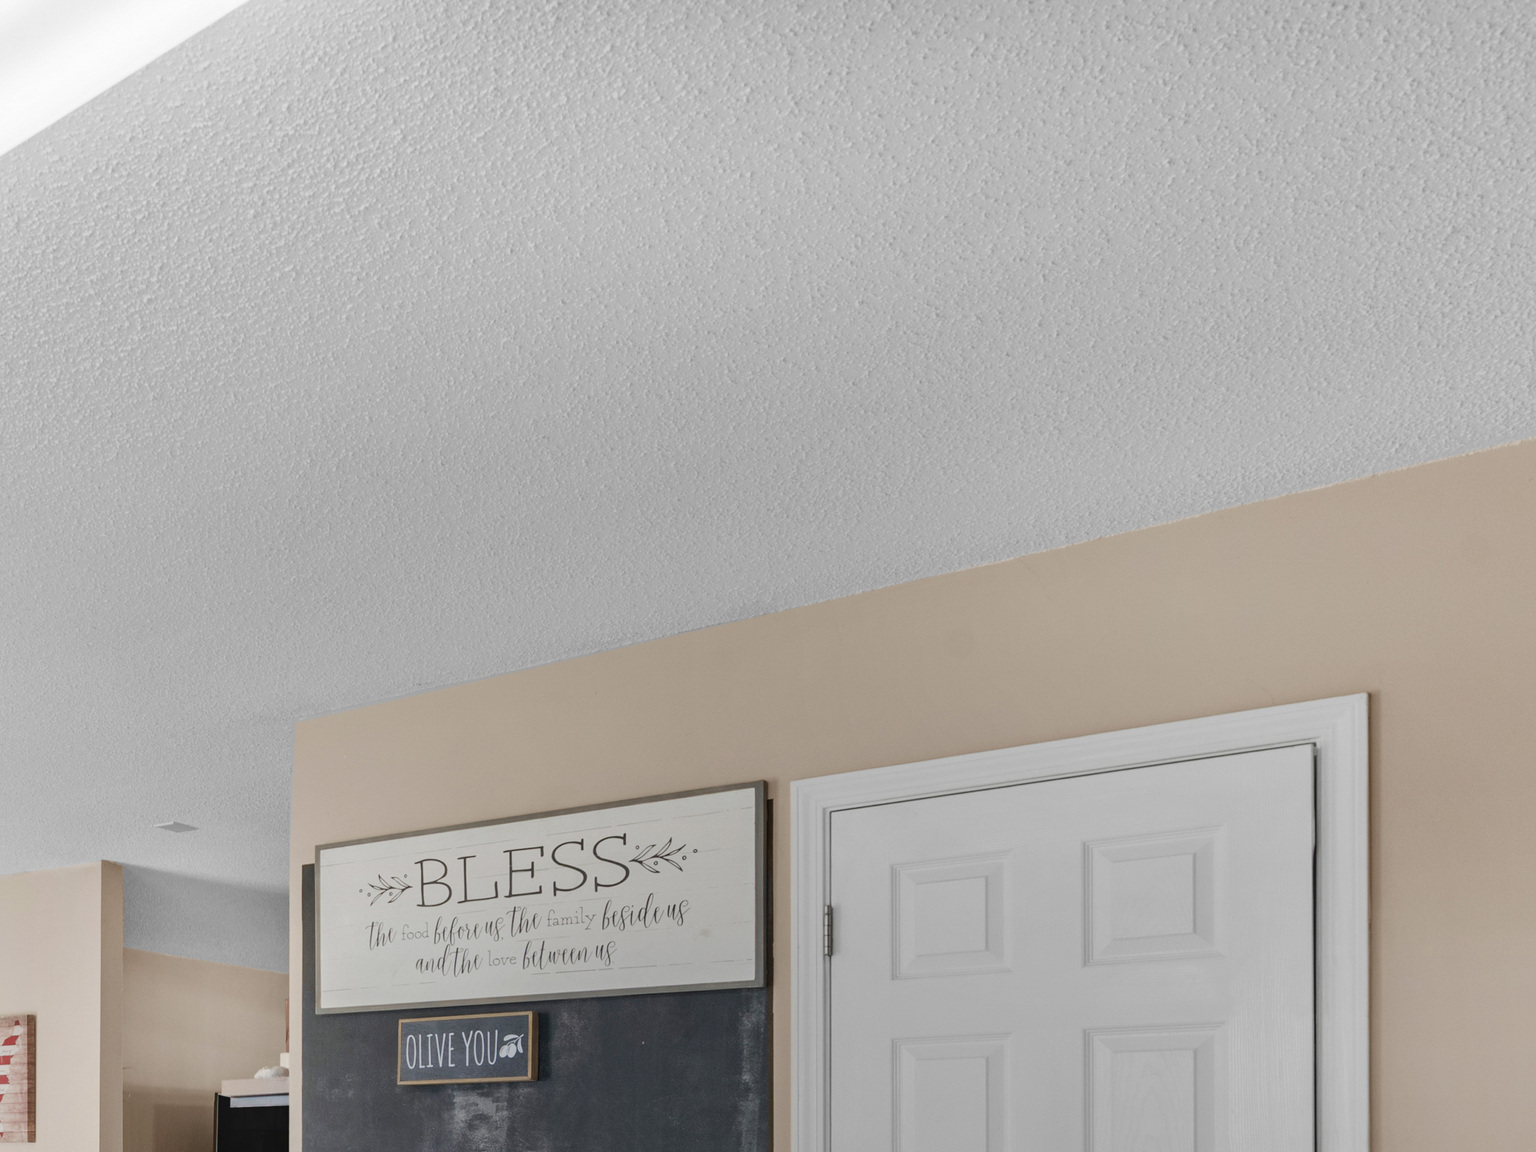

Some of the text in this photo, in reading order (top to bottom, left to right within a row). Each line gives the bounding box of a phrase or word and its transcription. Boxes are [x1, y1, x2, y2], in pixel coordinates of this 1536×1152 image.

[415, 833, 631, 907] BLESS
[365, 921, 397, 950] the
[401, 922, 429, 941] food
[434, 916, 483, 945] before
[506, 906, 542, 937] the
[547, 907, 596, 930] family
[602, 893, 664, 931] beside
[667, 900, 691, 926] us
[416, 944, 451, 976] and
[450, 947, 483, 977] the
[488, 950, 517, 967] love
[523, 940, 592, 970] between
[406, 1029, 498, 1069] OLIVE YOU
